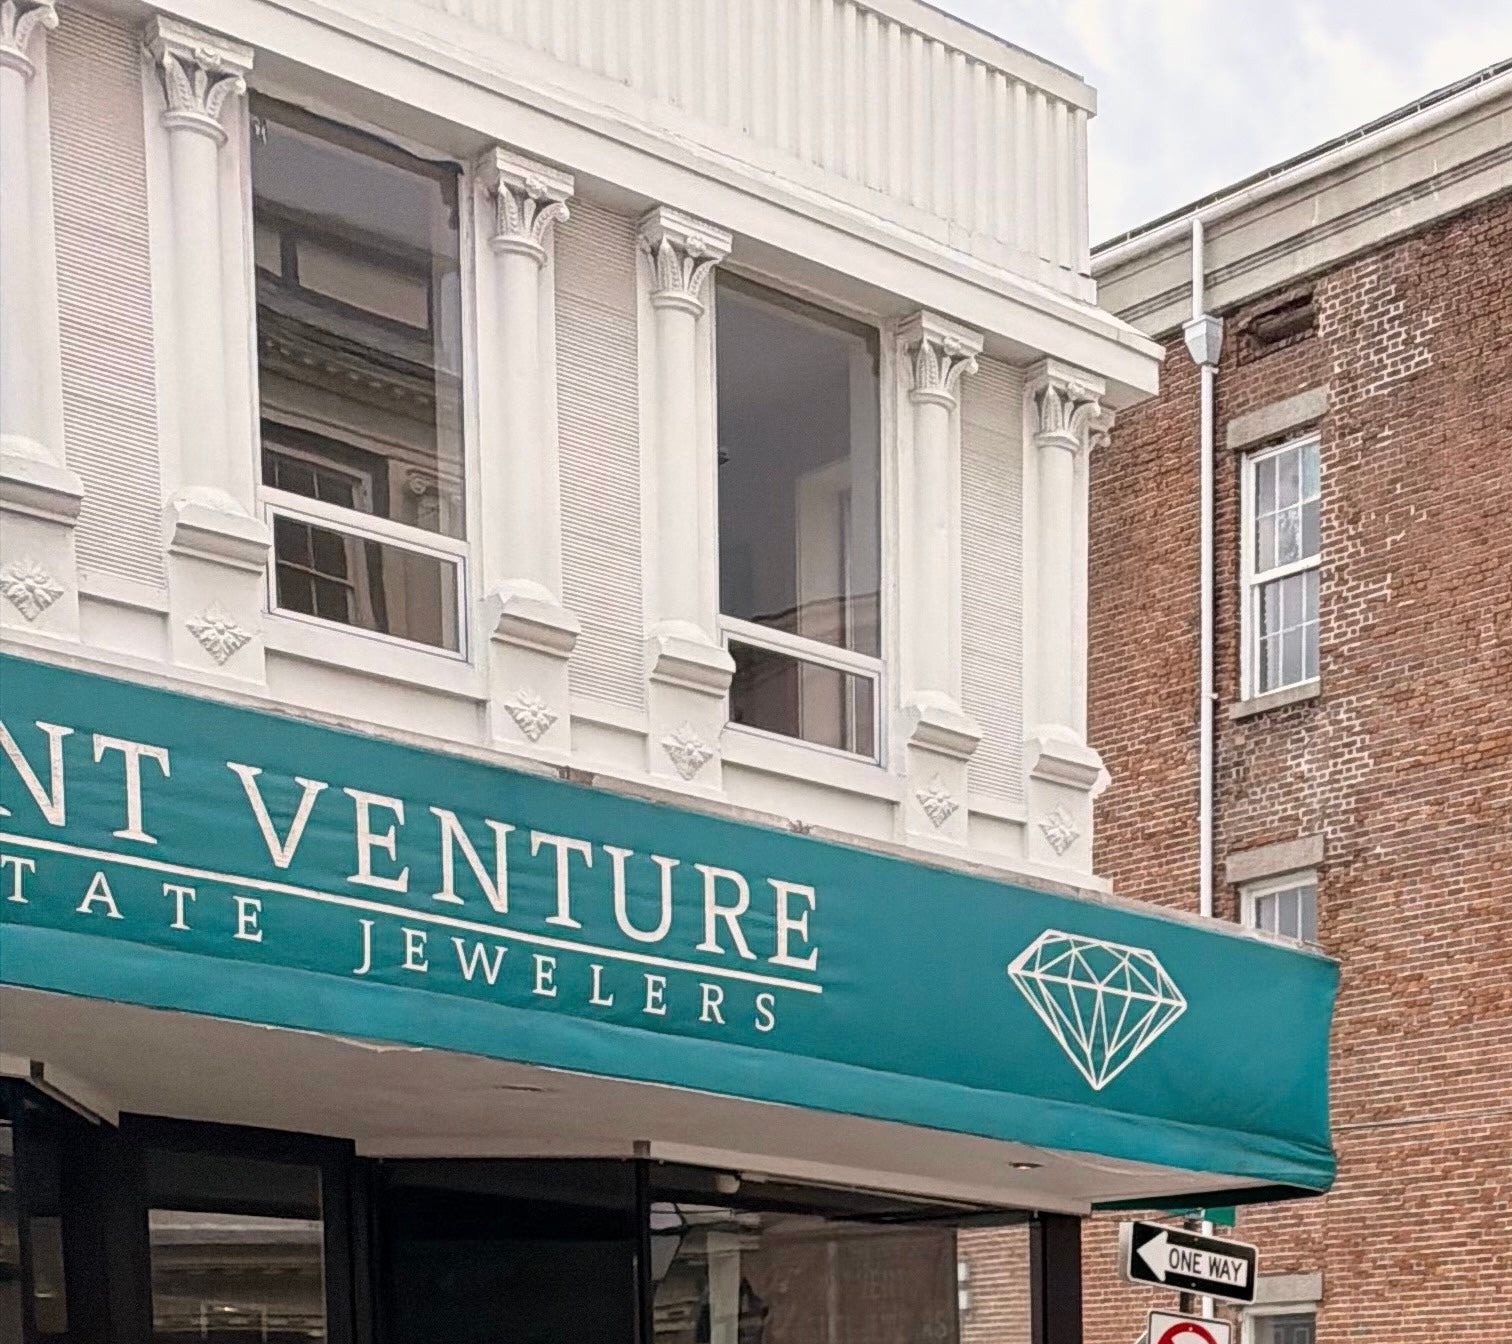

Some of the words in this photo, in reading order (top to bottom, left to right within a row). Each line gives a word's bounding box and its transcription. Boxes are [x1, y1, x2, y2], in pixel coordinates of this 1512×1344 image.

[0, 854, 264, 943] TATE
[352, 919, 778, 1033] JEWELERS
[226, 761, 820, 972] VENTURE
[1168, 1247, 1203, 1275] ONE
[1208, 1255, 1243, 1282] WAY
